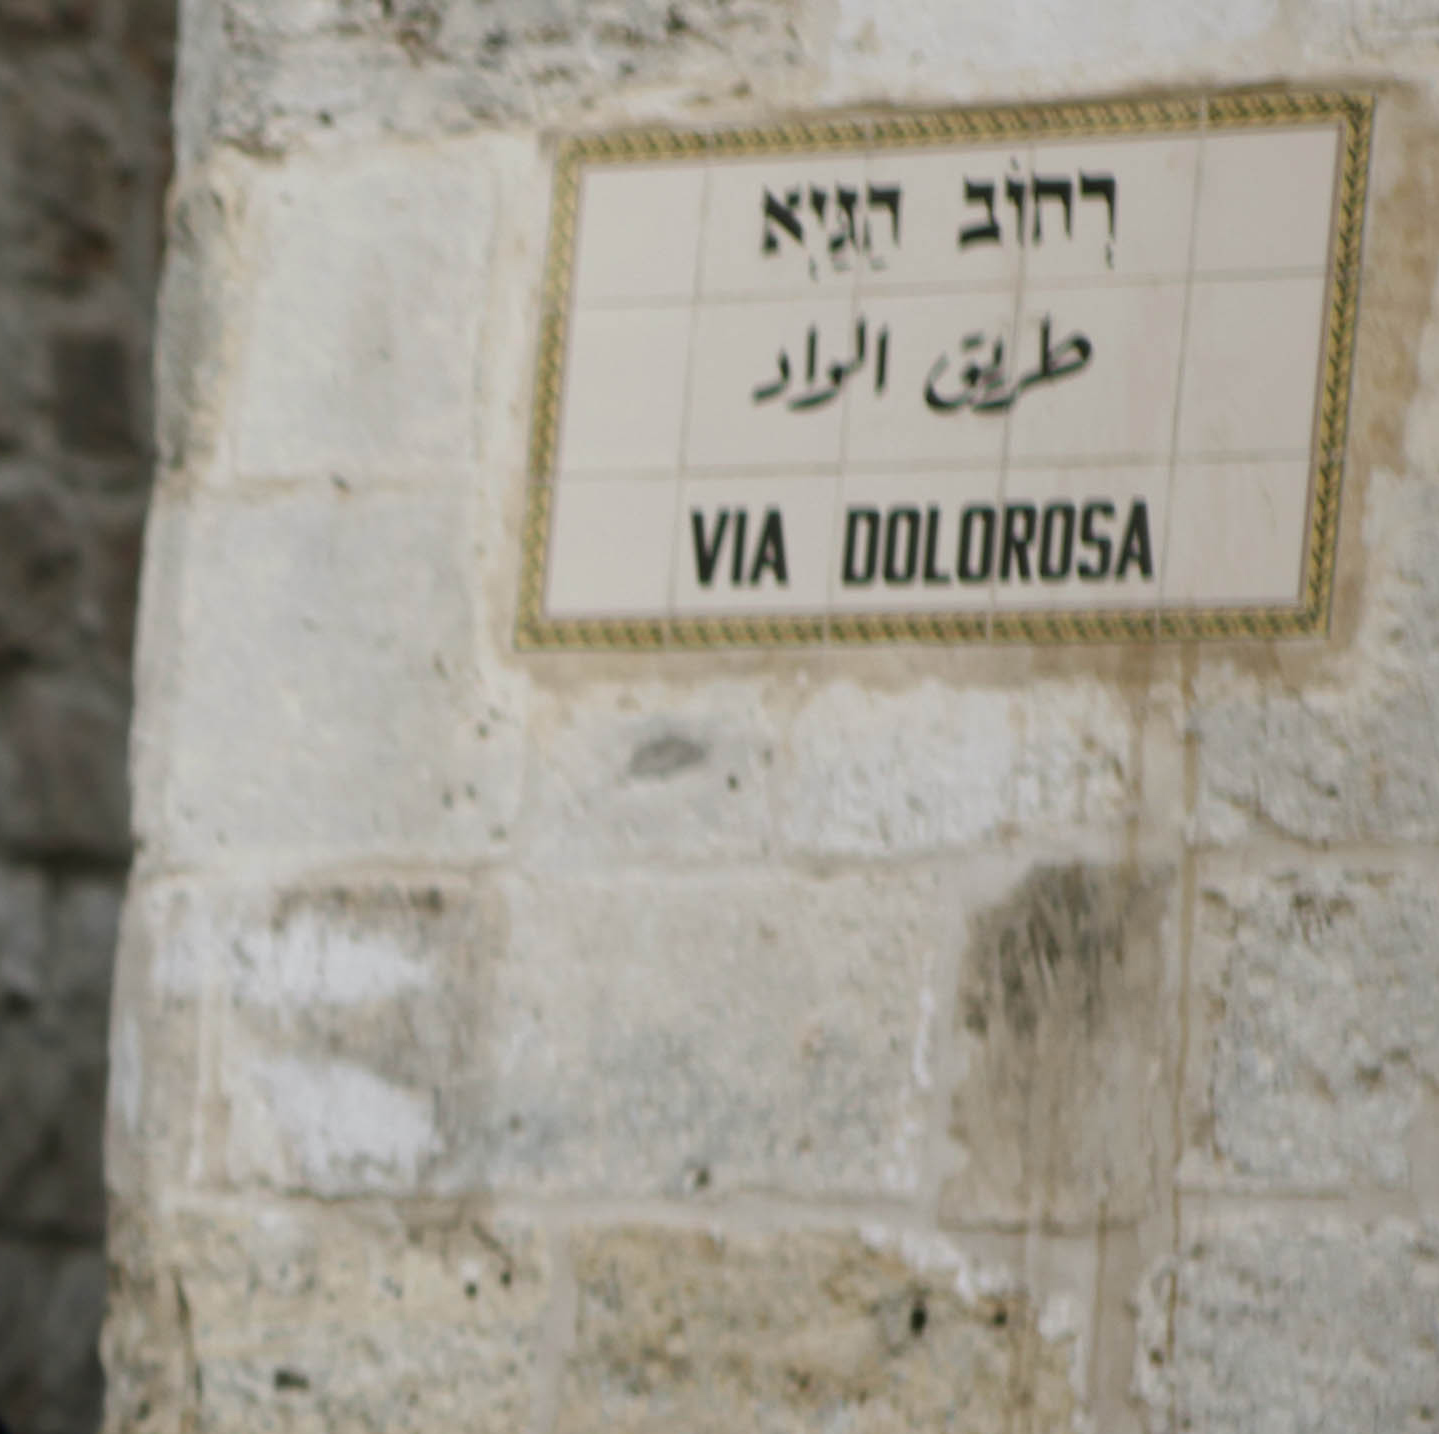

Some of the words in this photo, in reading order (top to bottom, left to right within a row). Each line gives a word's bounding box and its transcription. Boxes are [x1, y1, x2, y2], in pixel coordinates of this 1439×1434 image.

[751, 315, 891, 413] الواد
[922, 314, 1094, 417] طريق
[690, 506, 789, 590] VIA
[841, 499, 1154, 587] DOLOROSA
